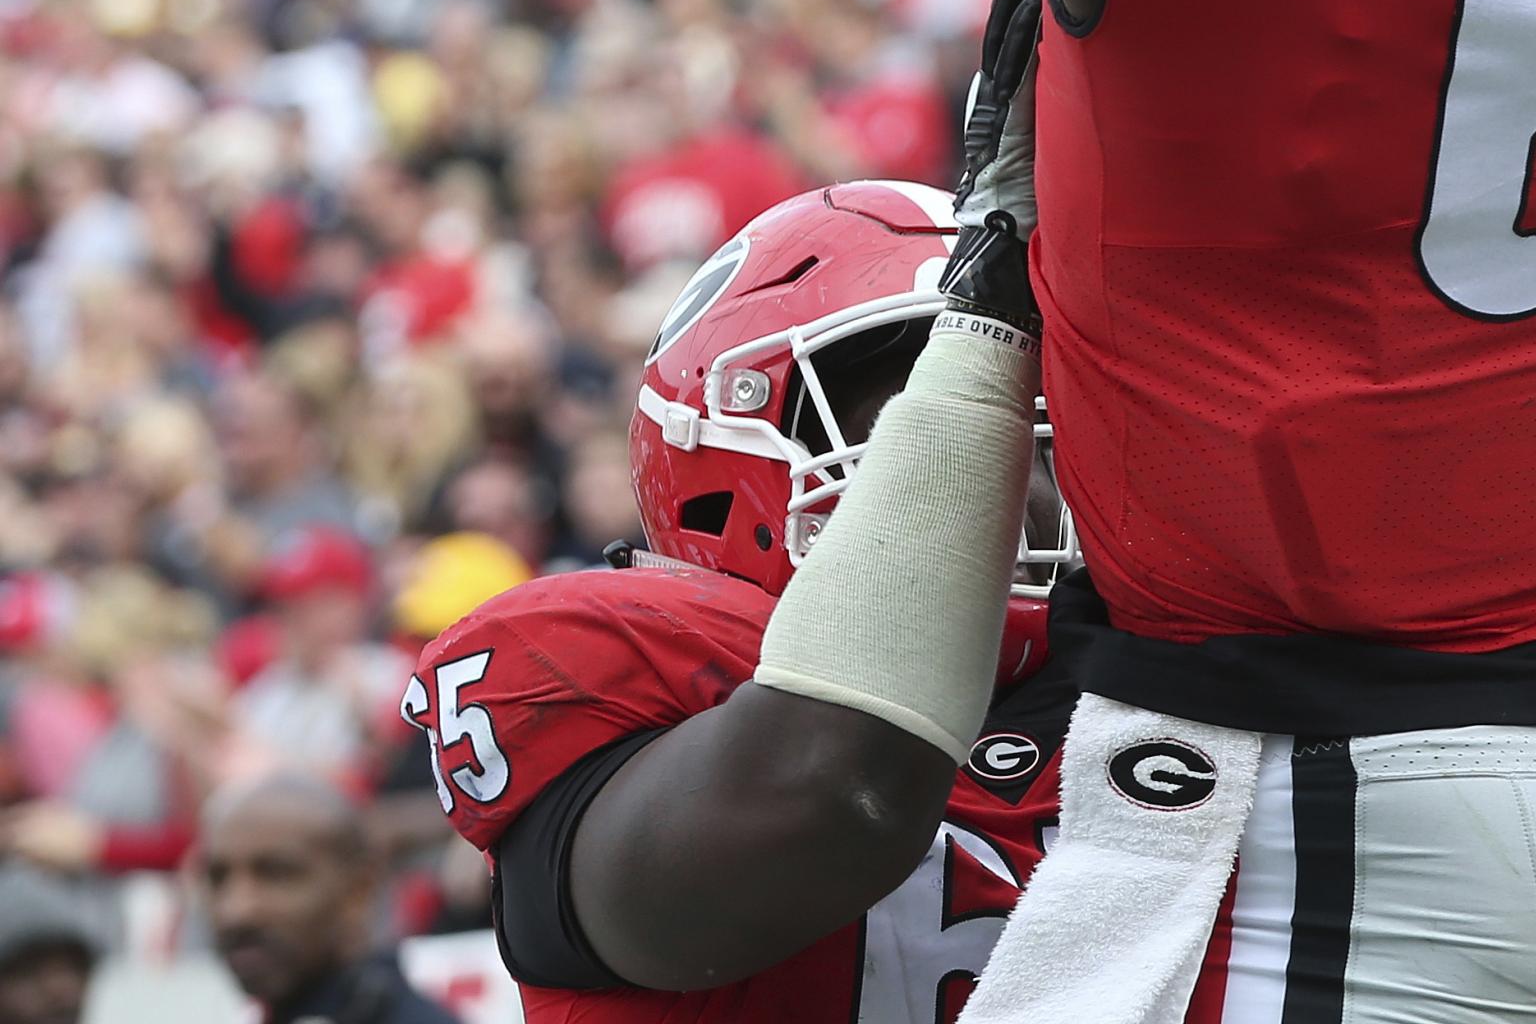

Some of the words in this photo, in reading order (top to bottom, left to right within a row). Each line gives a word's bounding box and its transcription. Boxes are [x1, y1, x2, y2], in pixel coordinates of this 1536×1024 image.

[970, 319, 1014, 345] OVER
[968, 734, 1039, 779] G
[1108, 740, 1217, 810] G
